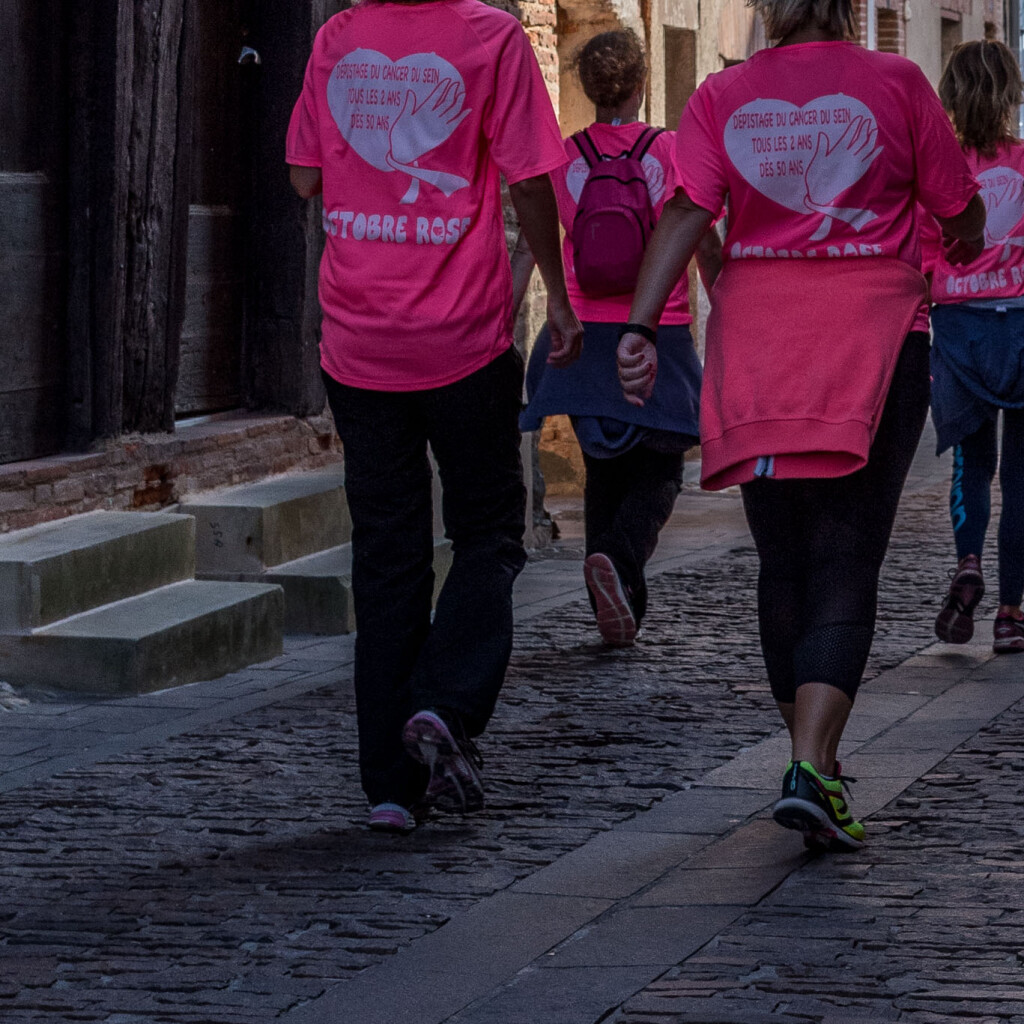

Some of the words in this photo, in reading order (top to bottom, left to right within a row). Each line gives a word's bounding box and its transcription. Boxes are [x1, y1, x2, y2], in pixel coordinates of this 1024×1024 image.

[370, 64, 380, 80] DU
[383, 64, 409, 81] CANCER
[411, 67, 421, 82] DU
[423, 68, 440, 84] SEIN
[348, 88, 364, 104] TOUS
[366, 88, 378, 105] LES
[380, 89, 385, 105] 2
[387, 90, 401, 106] ANS
[351, 109, 364, 129] DÈS
[366, 114, 375, 129] 50
[376, 115, 390, 131] ANS
[733, 109, 773, 130] DÉPISTAGE
[776, 112, 787, 127] DU
[789, 110, 818, 127] CANCER
[820, 109, 830, 125] DU
[833, 108, 851, 124] SEIN
[752, 136, 772, 154] TOUS
[774, 135, 787, 152] LES
[790, 135, 795, 150] 2
[797, 134, 813, 150] ANS
[759, 156, 774, 178] DÈS
[776, 161, 787, 176] 50
[788, 160, 804, 176] ANS
[946, 268, 1007, 295] OCTOBRE
